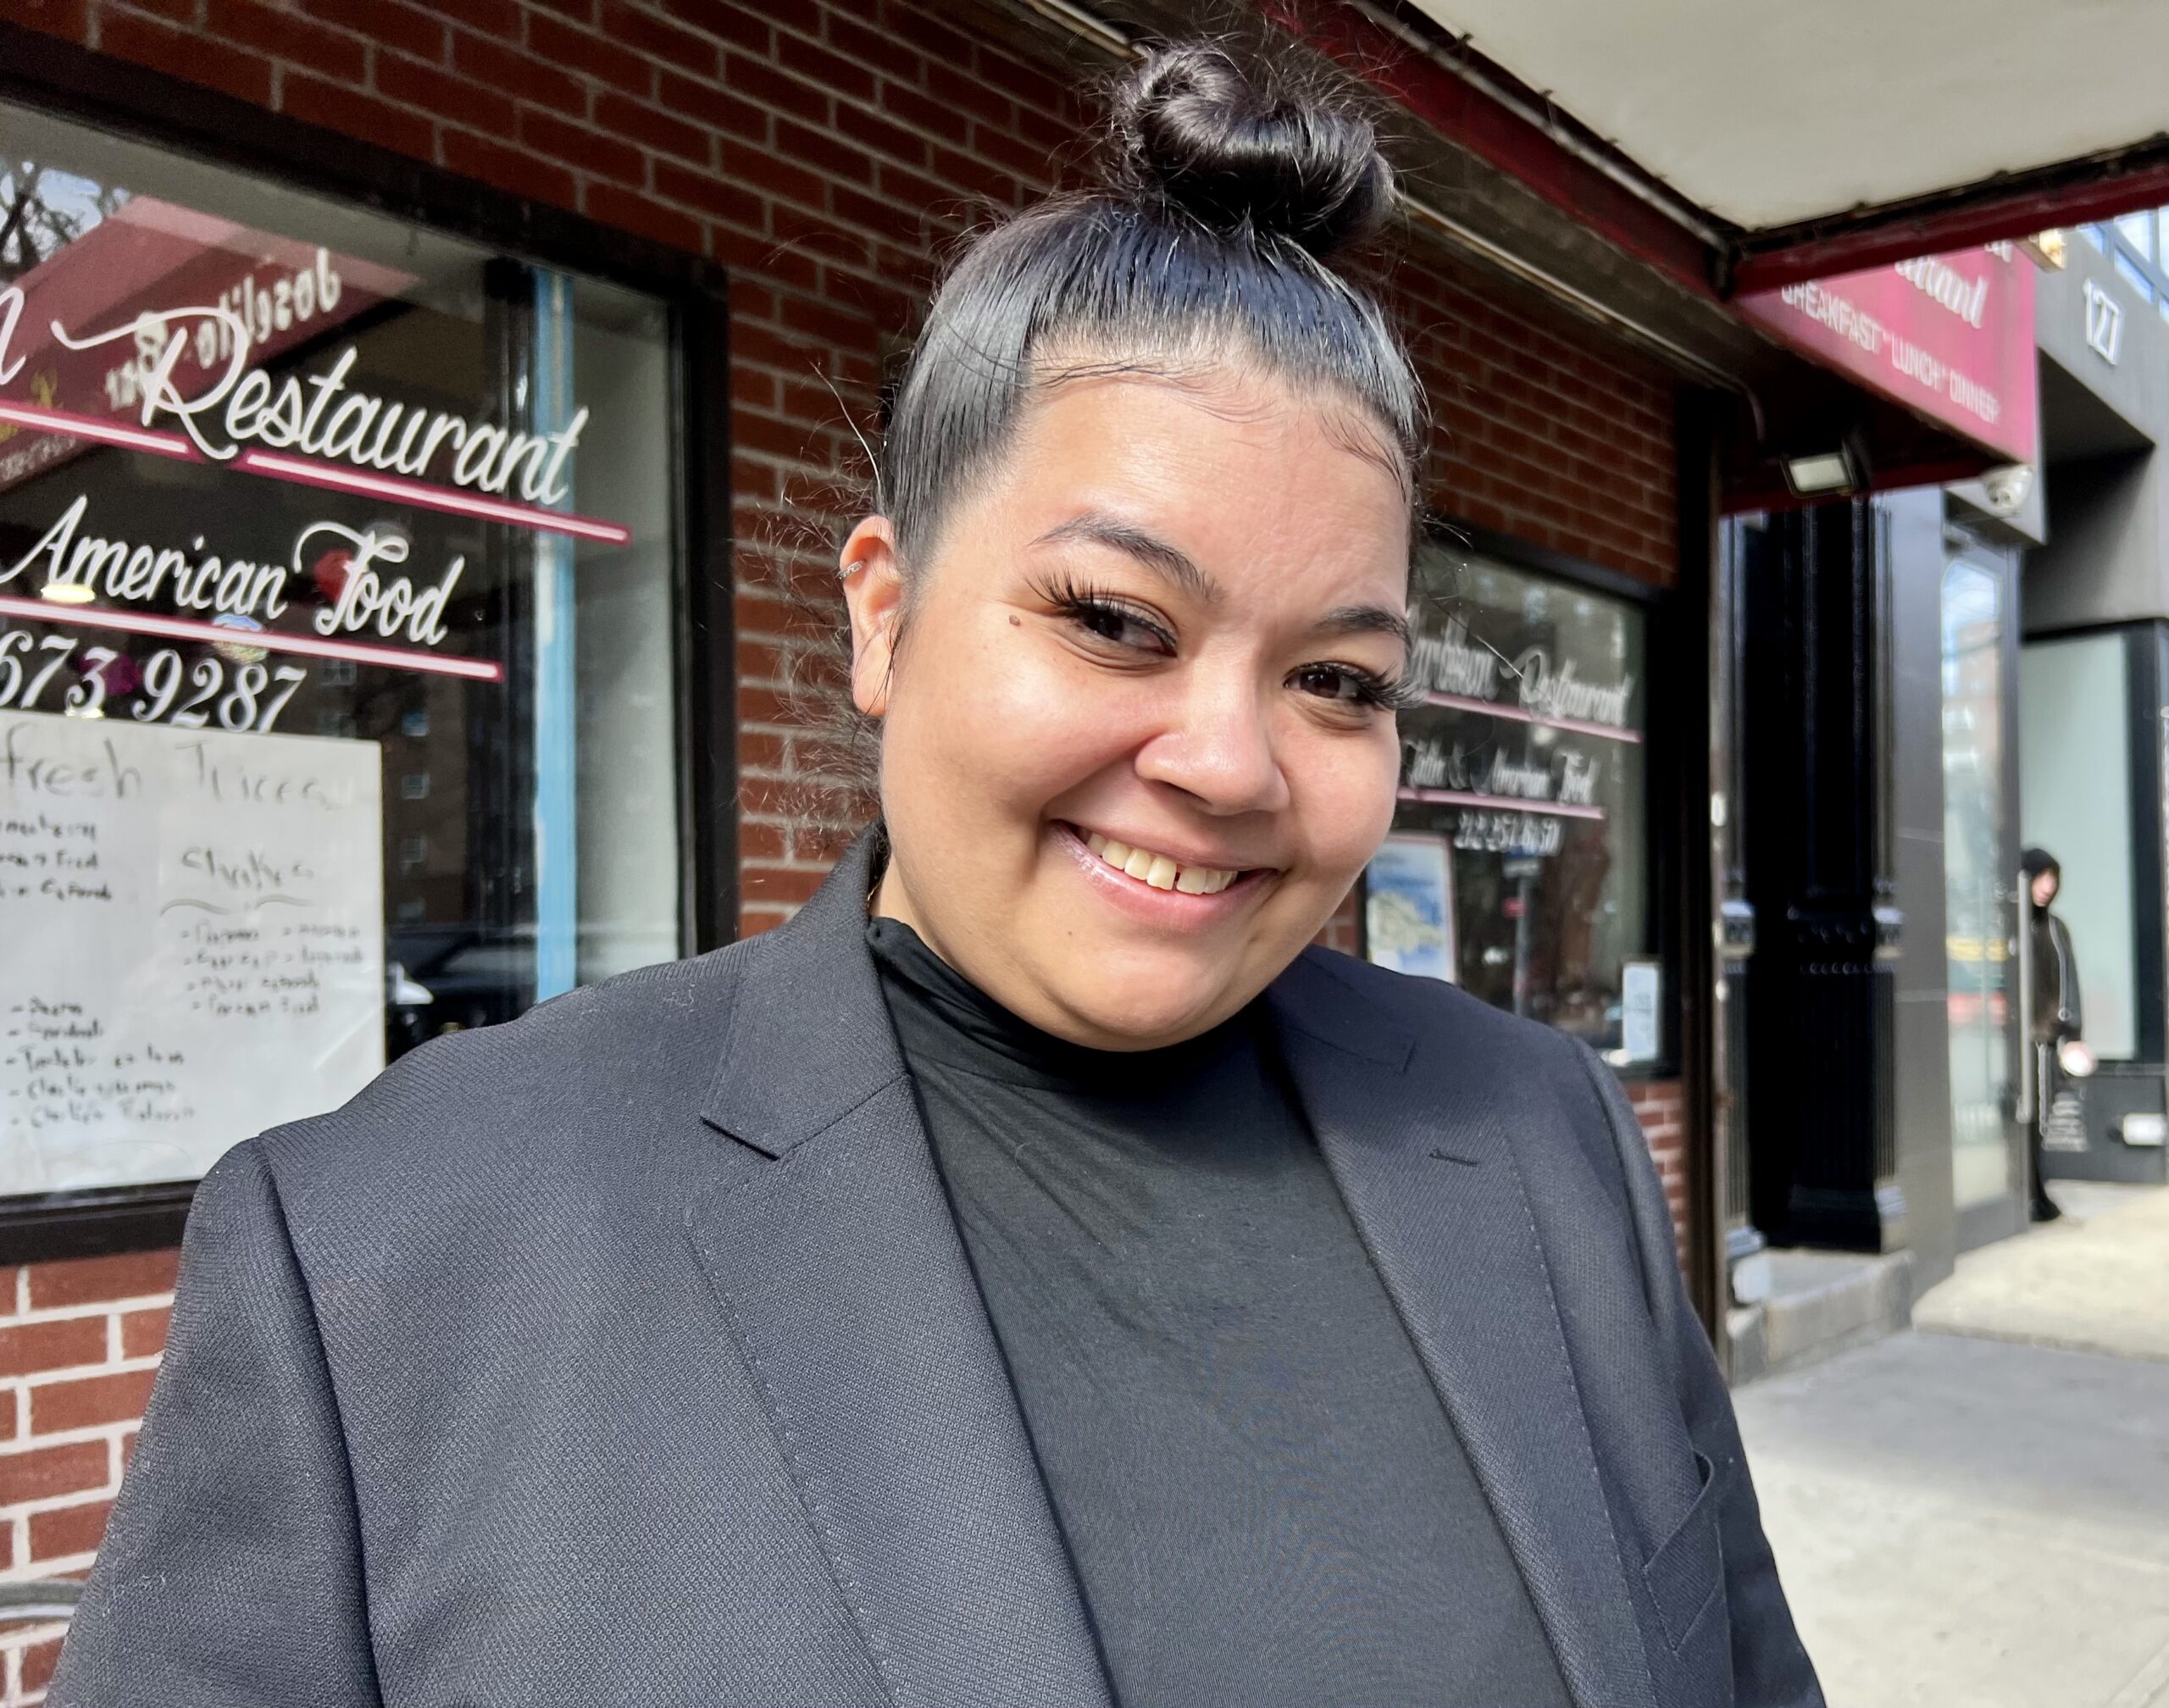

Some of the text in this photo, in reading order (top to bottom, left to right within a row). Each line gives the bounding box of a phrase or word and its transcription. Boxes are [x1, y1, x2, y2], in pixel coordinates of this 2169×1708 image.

[2083, 276, 2120, 367] 127
[51, 307, 590, 505] Restaurant
[1892, 334, 1944, 391] LUNCH
[1950, 369, 2000, 424] DINNER
[0, 495, 465, 646] American Food
[0, 630, 308, 734] 673 9287
